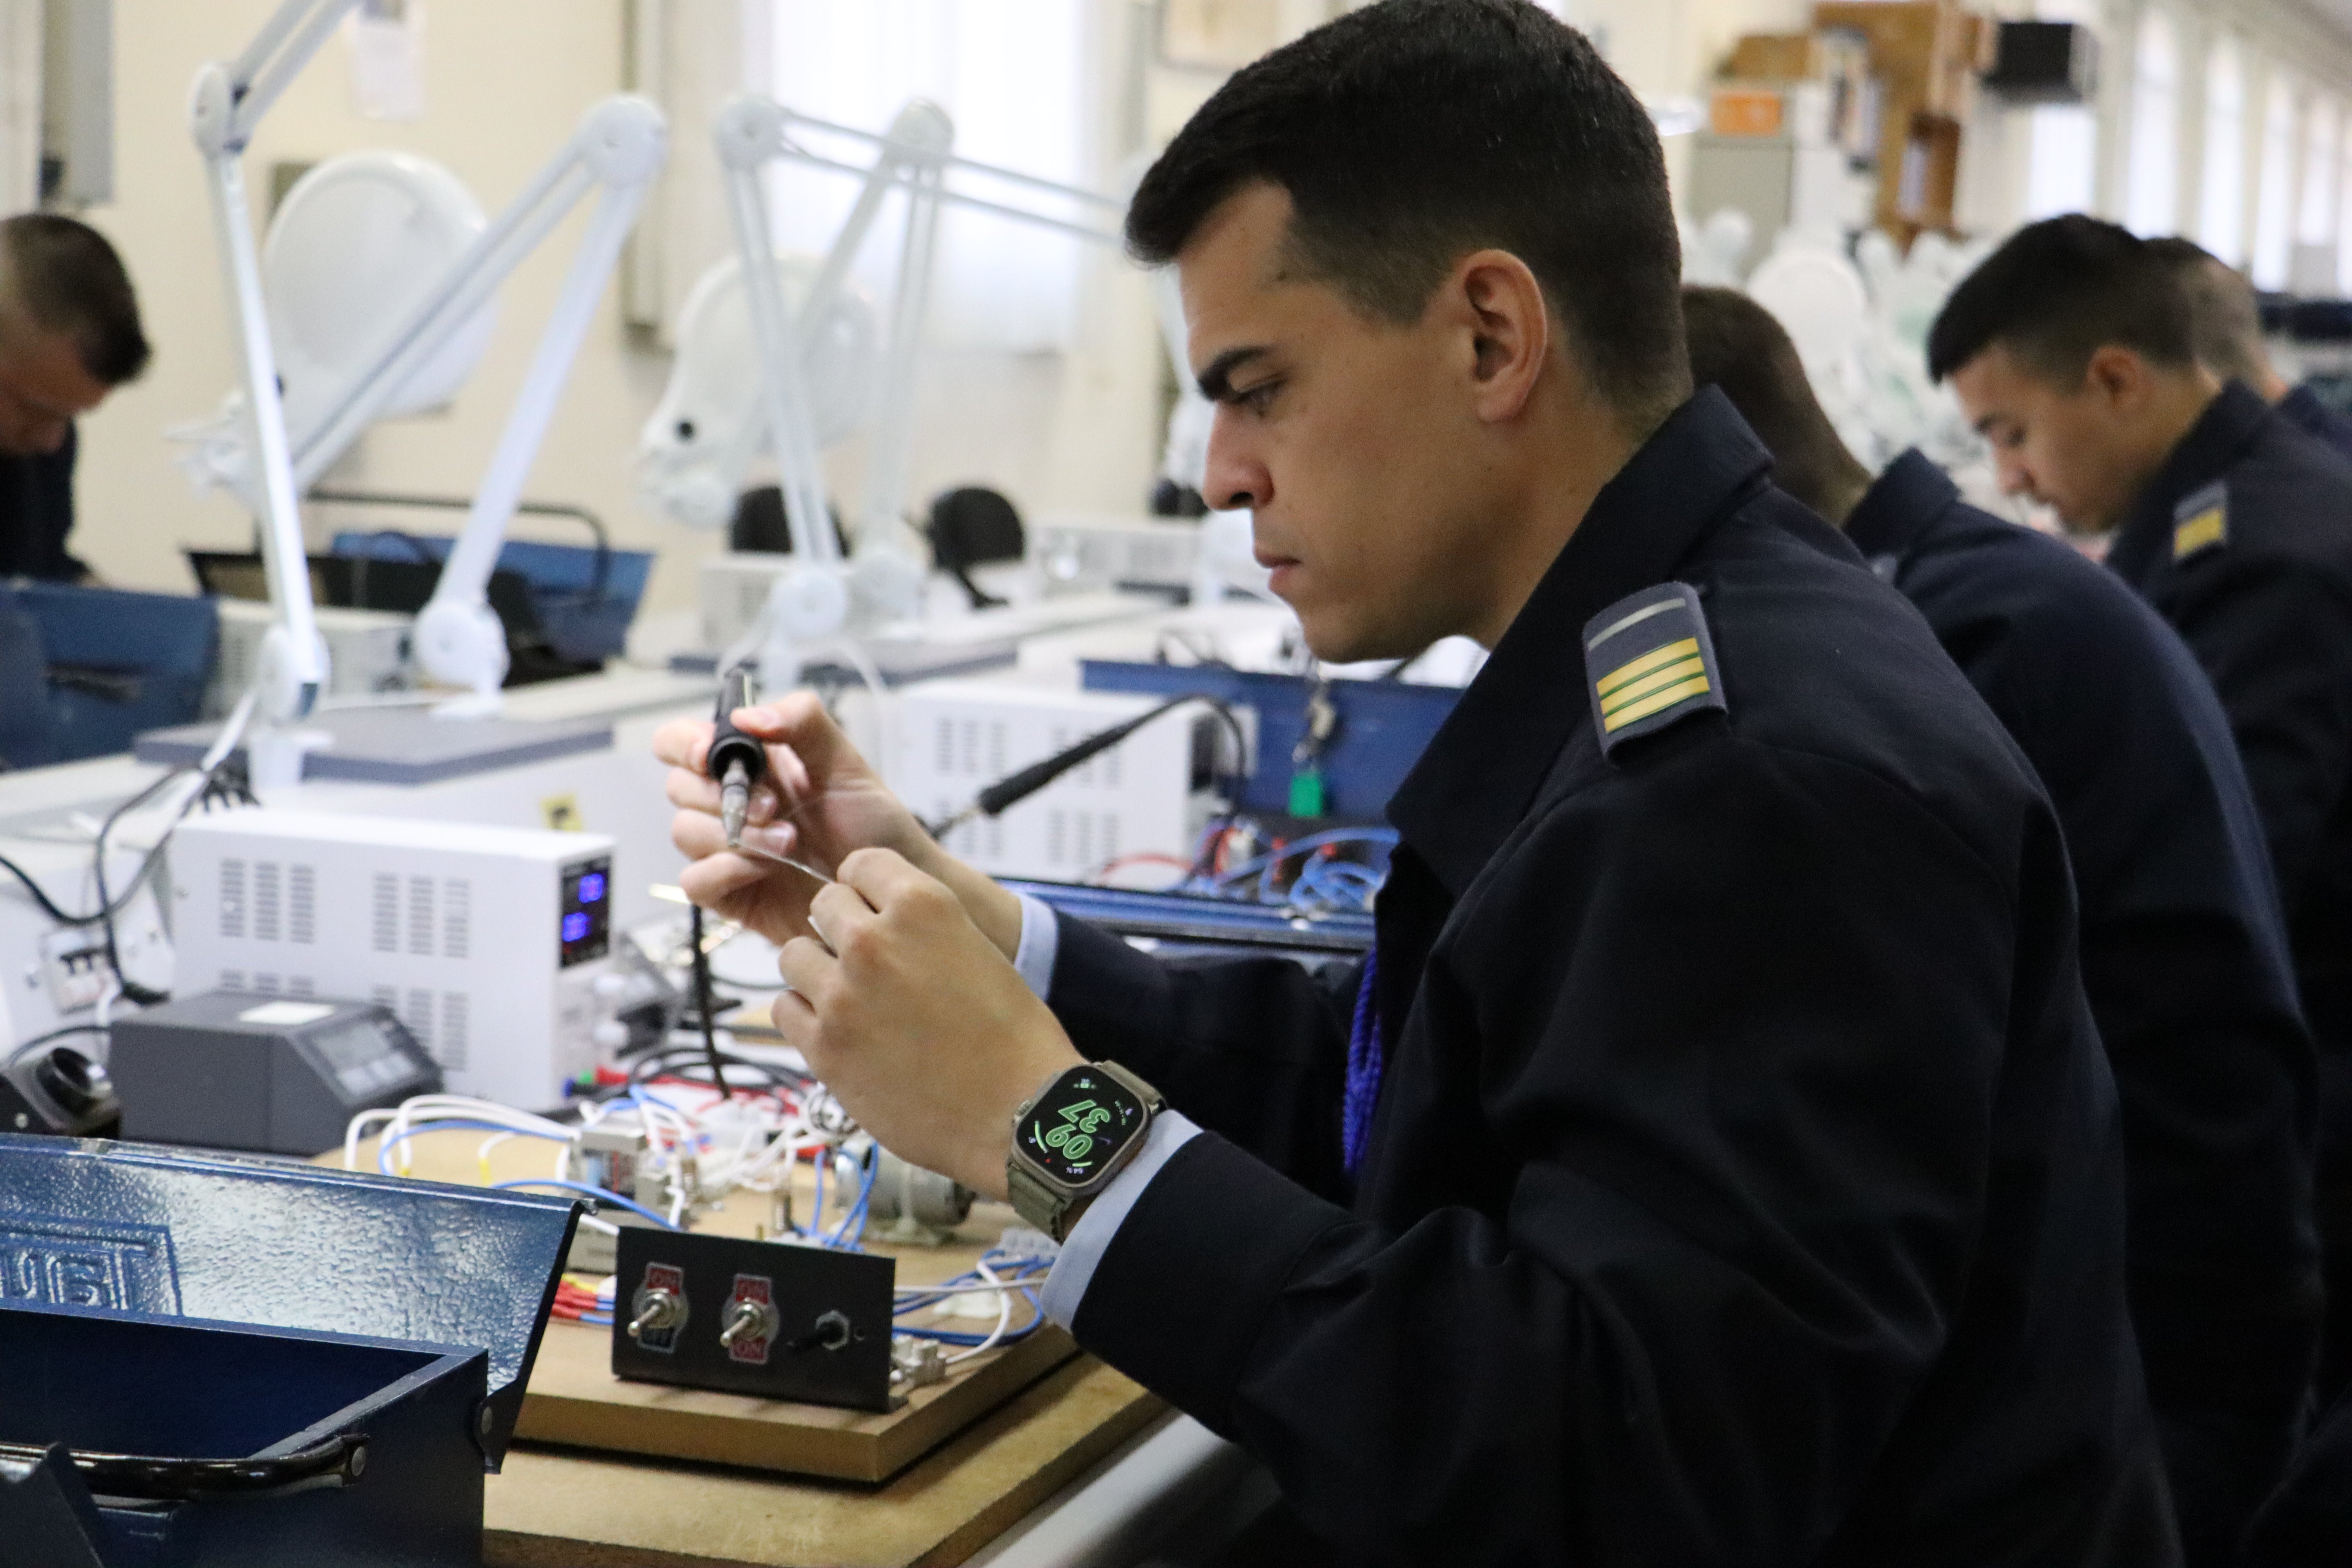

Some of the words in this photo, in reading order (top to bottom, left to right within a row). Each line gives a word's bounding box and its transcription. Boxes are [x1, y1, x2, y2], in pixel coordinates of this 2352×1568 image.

[1057, 1099, 1110, 1133] 37
[1045, 1123, 1093, 1160] 09
[733, 1340, 764, 1357] ON
